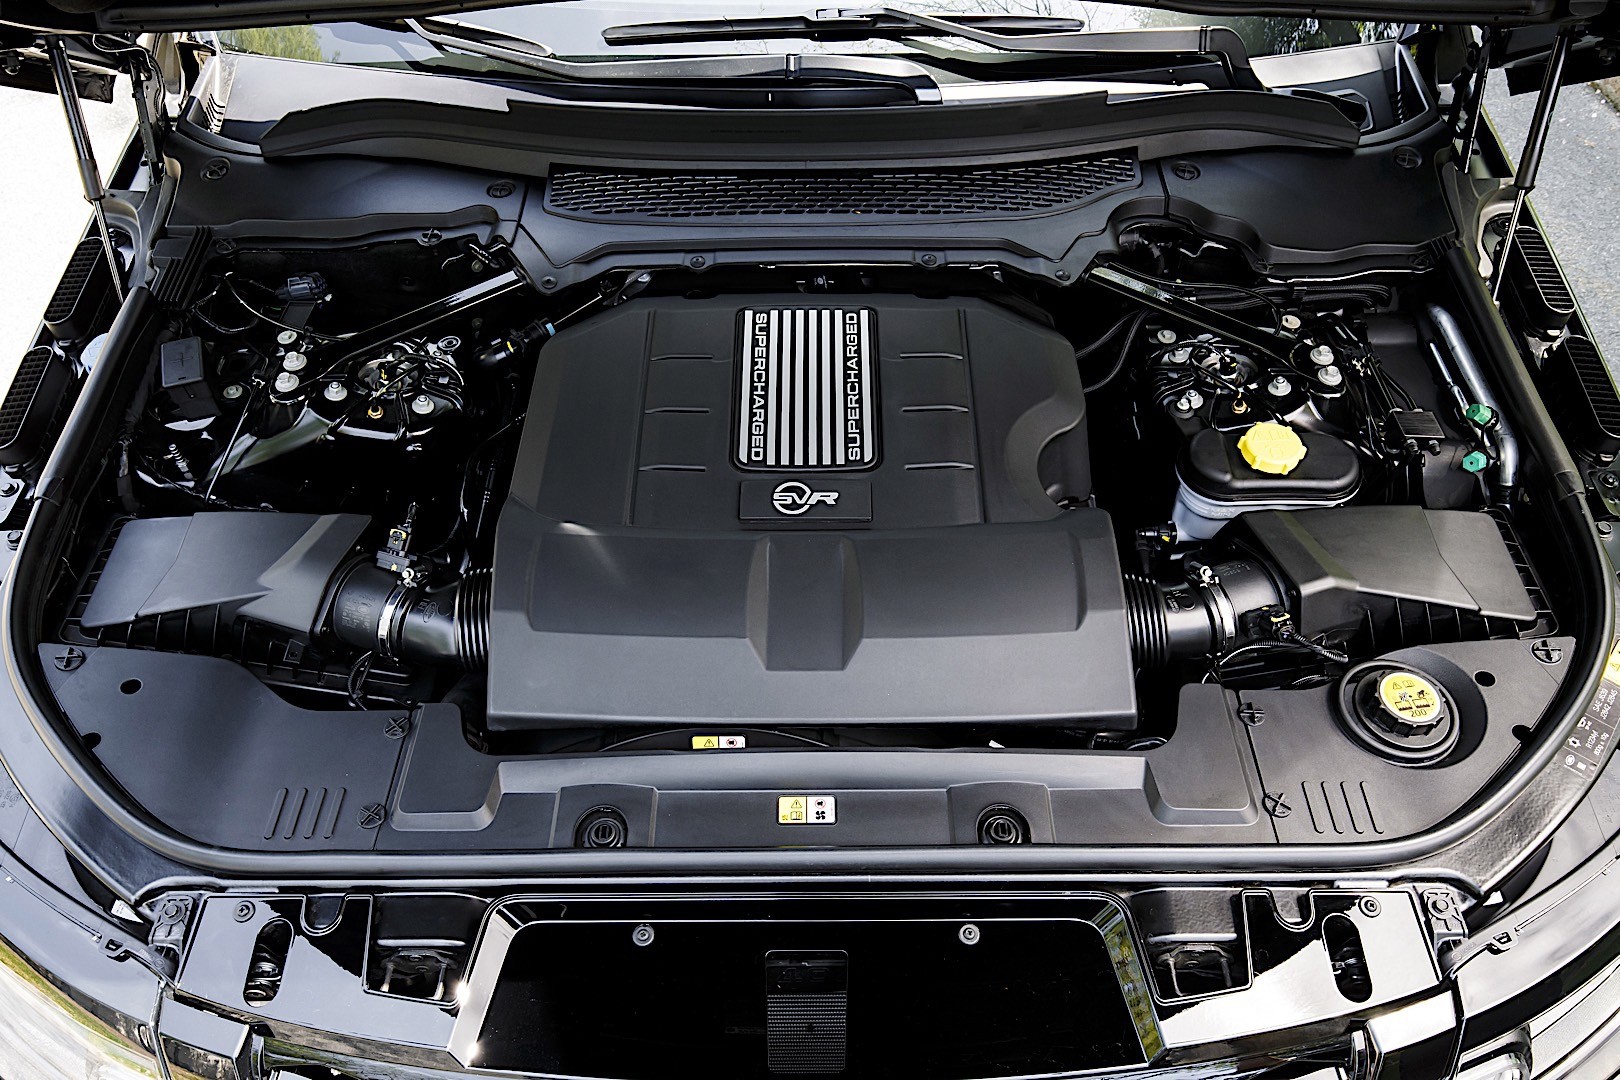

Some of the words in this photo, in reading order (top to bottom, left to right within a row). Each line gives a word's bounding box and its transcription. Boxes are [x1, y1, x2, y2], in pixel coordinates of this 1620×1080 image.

[751, 312, 767, 461] SUPERCHARGED
[845, 312, 861, 461] SUPERCHARGED
[1409, 709, 1427, 717] 200
